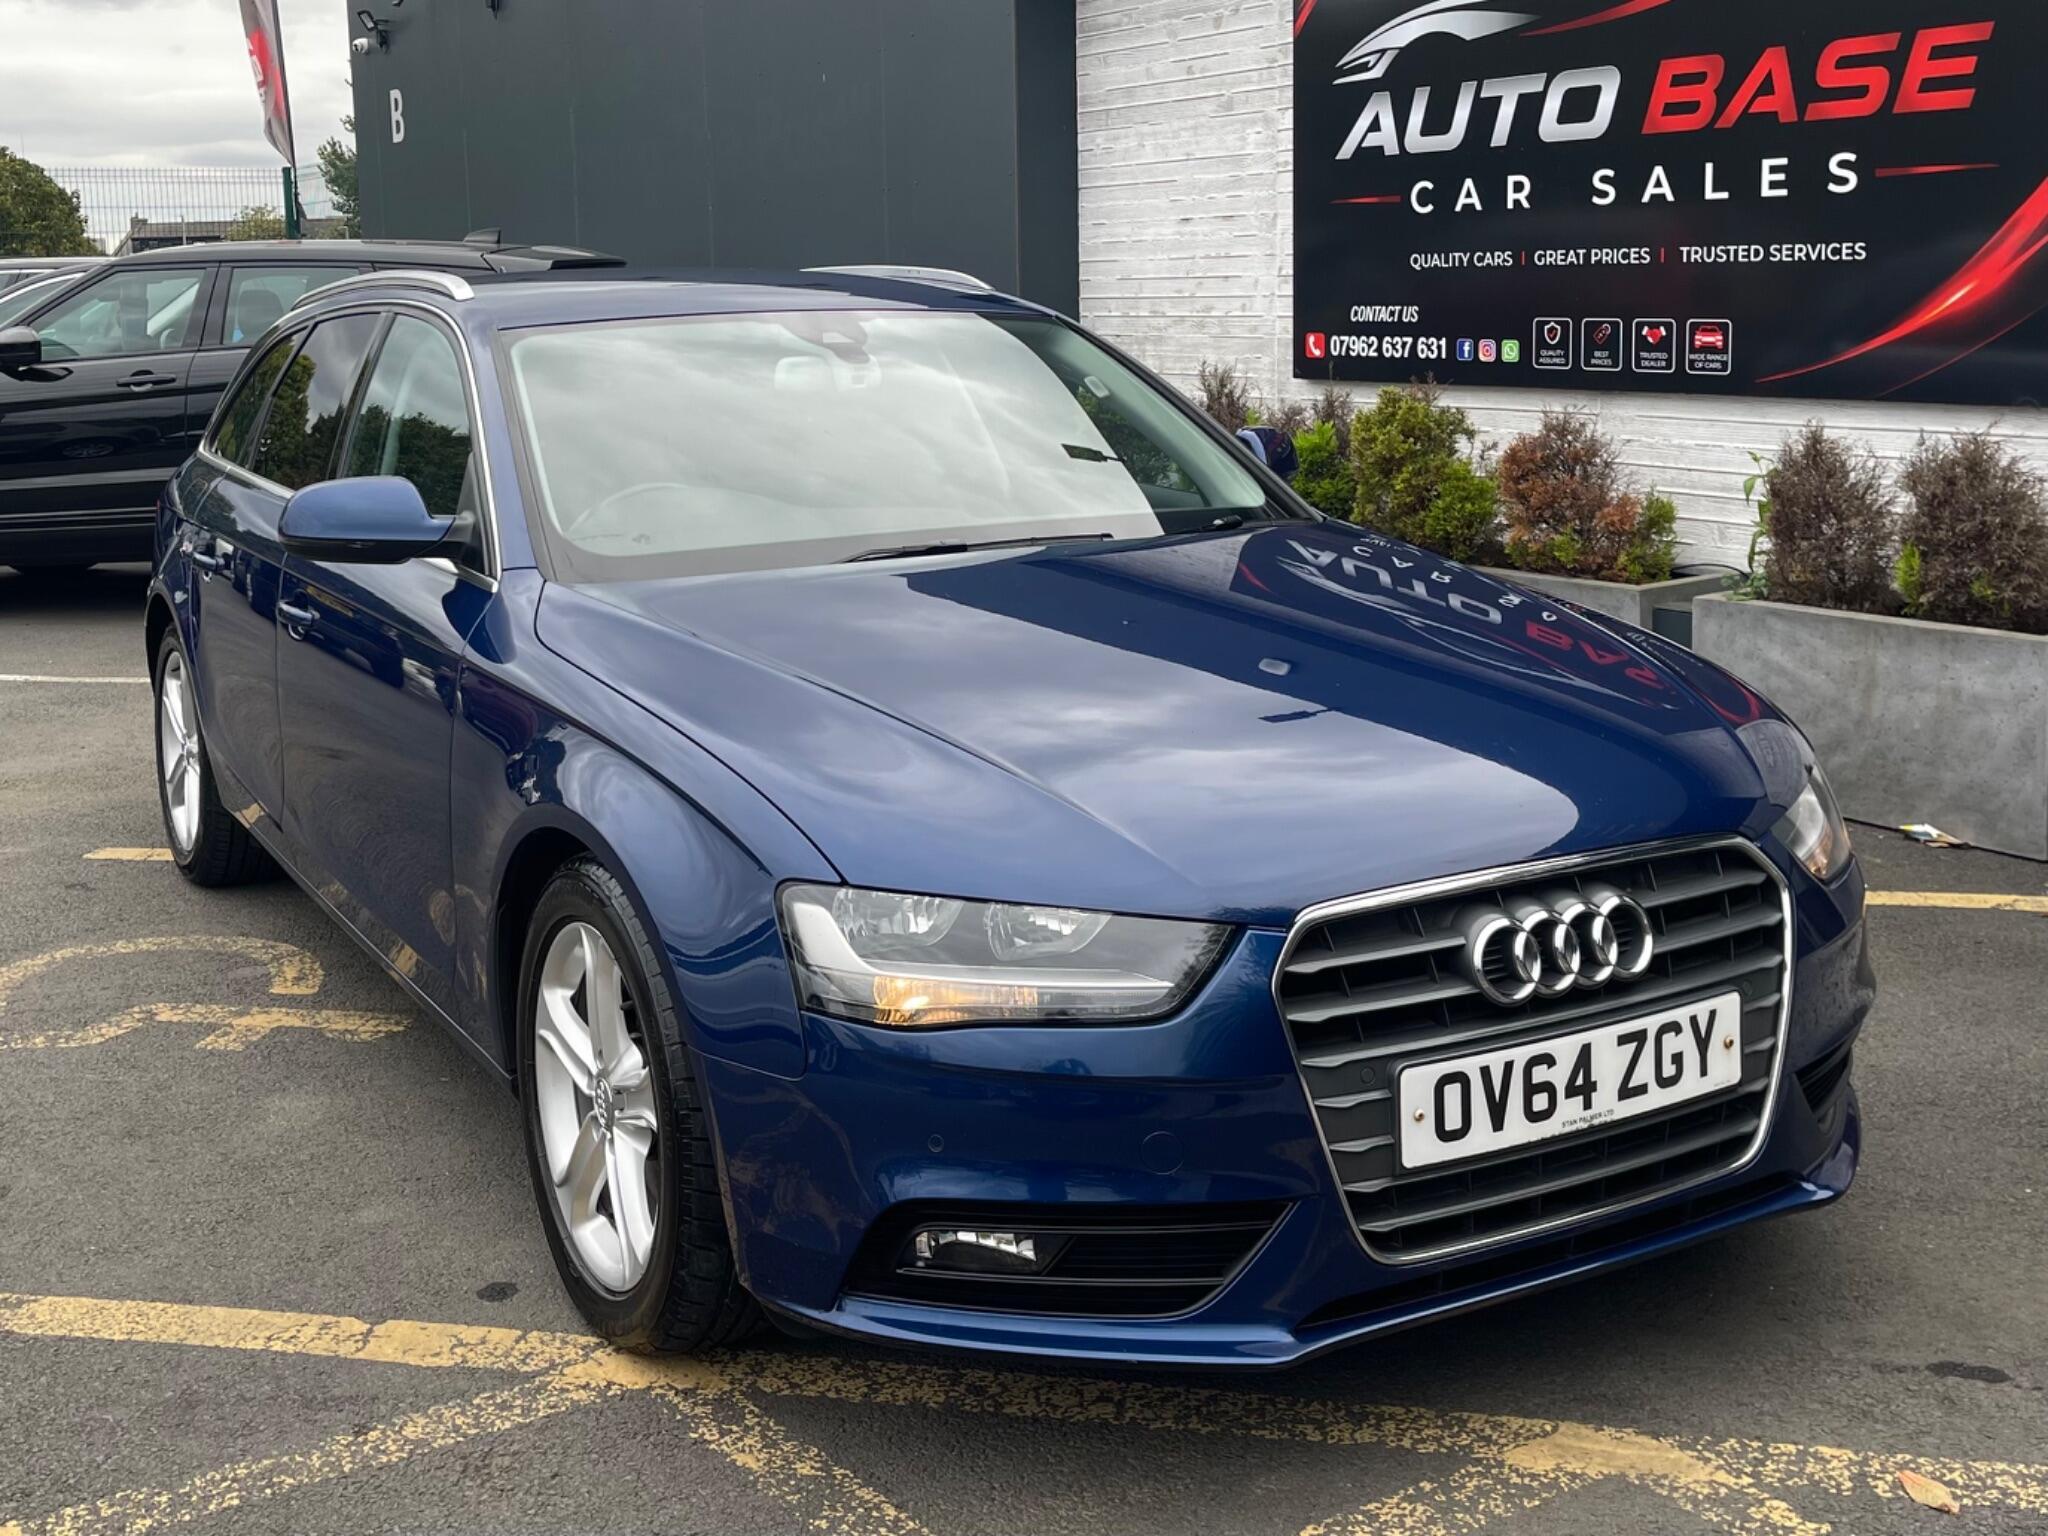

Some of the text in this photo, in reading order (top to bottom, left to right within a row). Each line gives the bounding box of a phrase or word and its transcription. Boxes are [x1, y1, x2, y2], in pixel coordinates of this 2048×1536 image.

[1335, 21, 1995, 160] AUTO BASE
[390, 88, 405, 143] B
[1410, 152, 1858, 213] CAR SALES
[1410, 242, 1867, 270] QUALITY CARS GREAT PRICES TRUSTED SERVICES
[1350, 305, 1419, 322] CONTACT US
[1330, 335, 1447, 359] 07962 637 631
[1593, 350, 1609, 358] BEST
[1591, 358, 1612, 366] PRICES
[1641, 359, 1666, 367] DEALER
[1704, 361, 1722, 369] CARS
[1434, 1009, 1717, 1142] OV64 ZGY
[1562, 1109, 1615, 1128] STAN PALMER LTD
